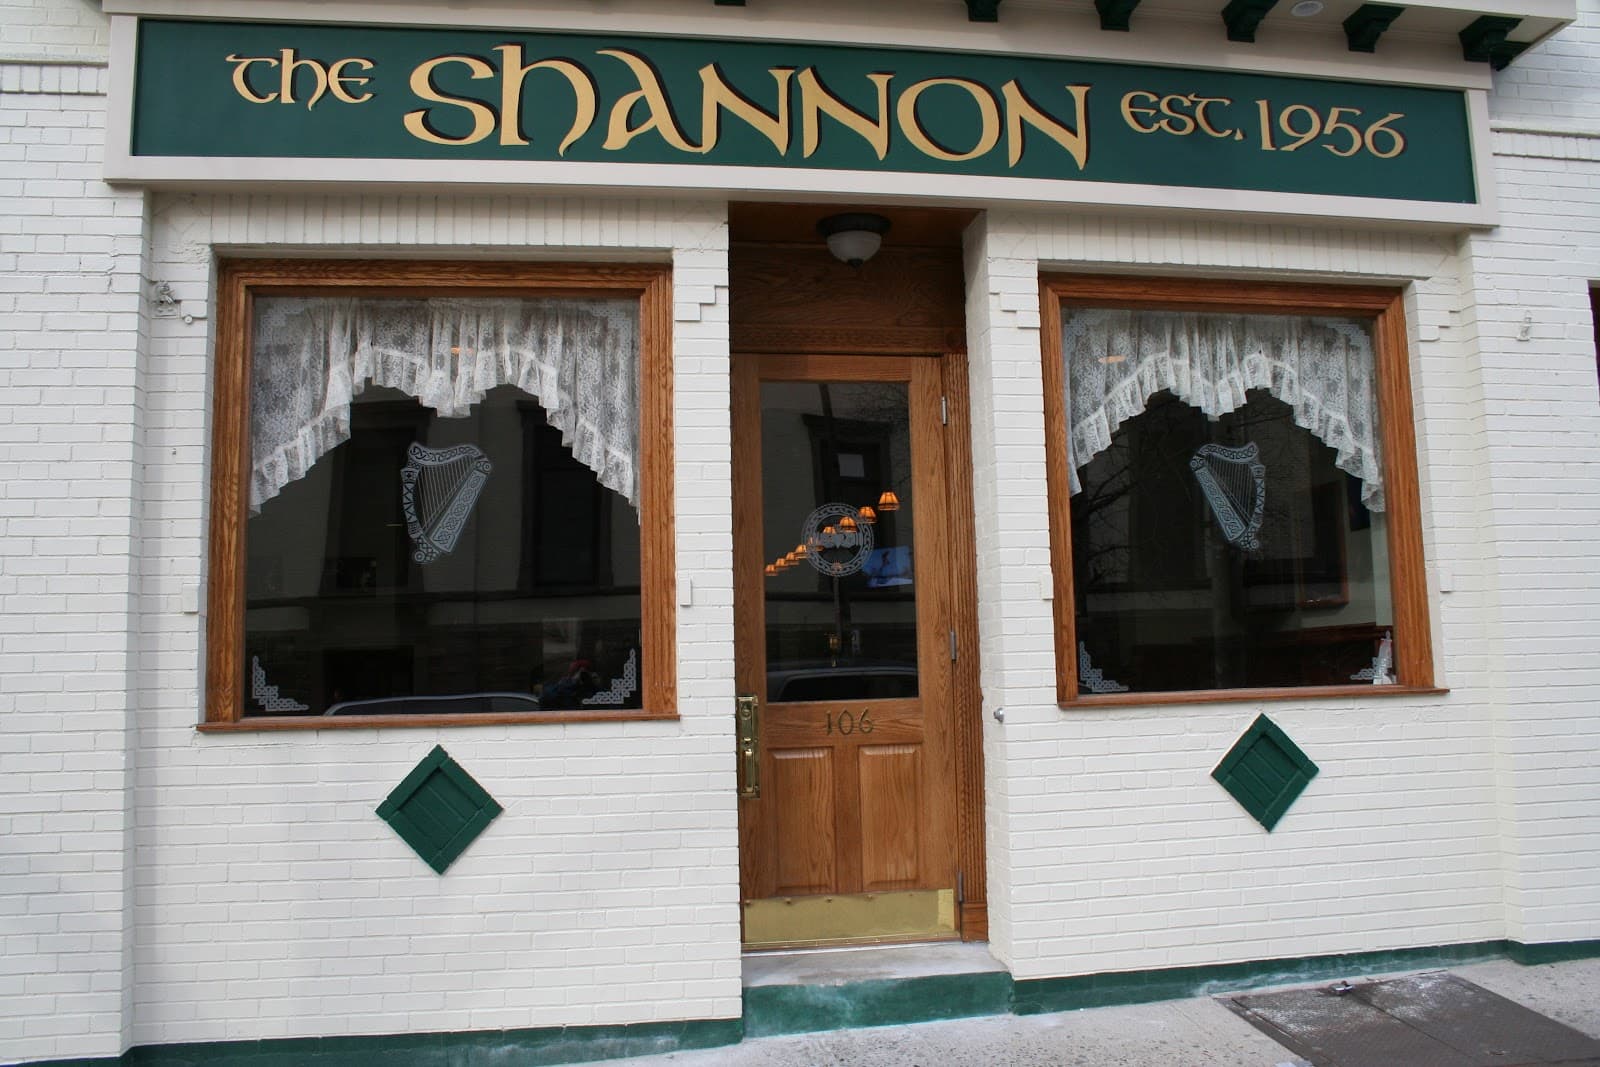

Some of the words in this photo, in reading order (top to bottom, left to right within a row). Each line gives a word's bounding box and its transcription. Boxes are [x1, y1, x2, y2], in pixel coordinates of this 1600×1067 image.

[403, 42, 1093, 172] SHANNON
[1255, 99, 1406, 159] 1956
[825, 706, 874, 736] 106
